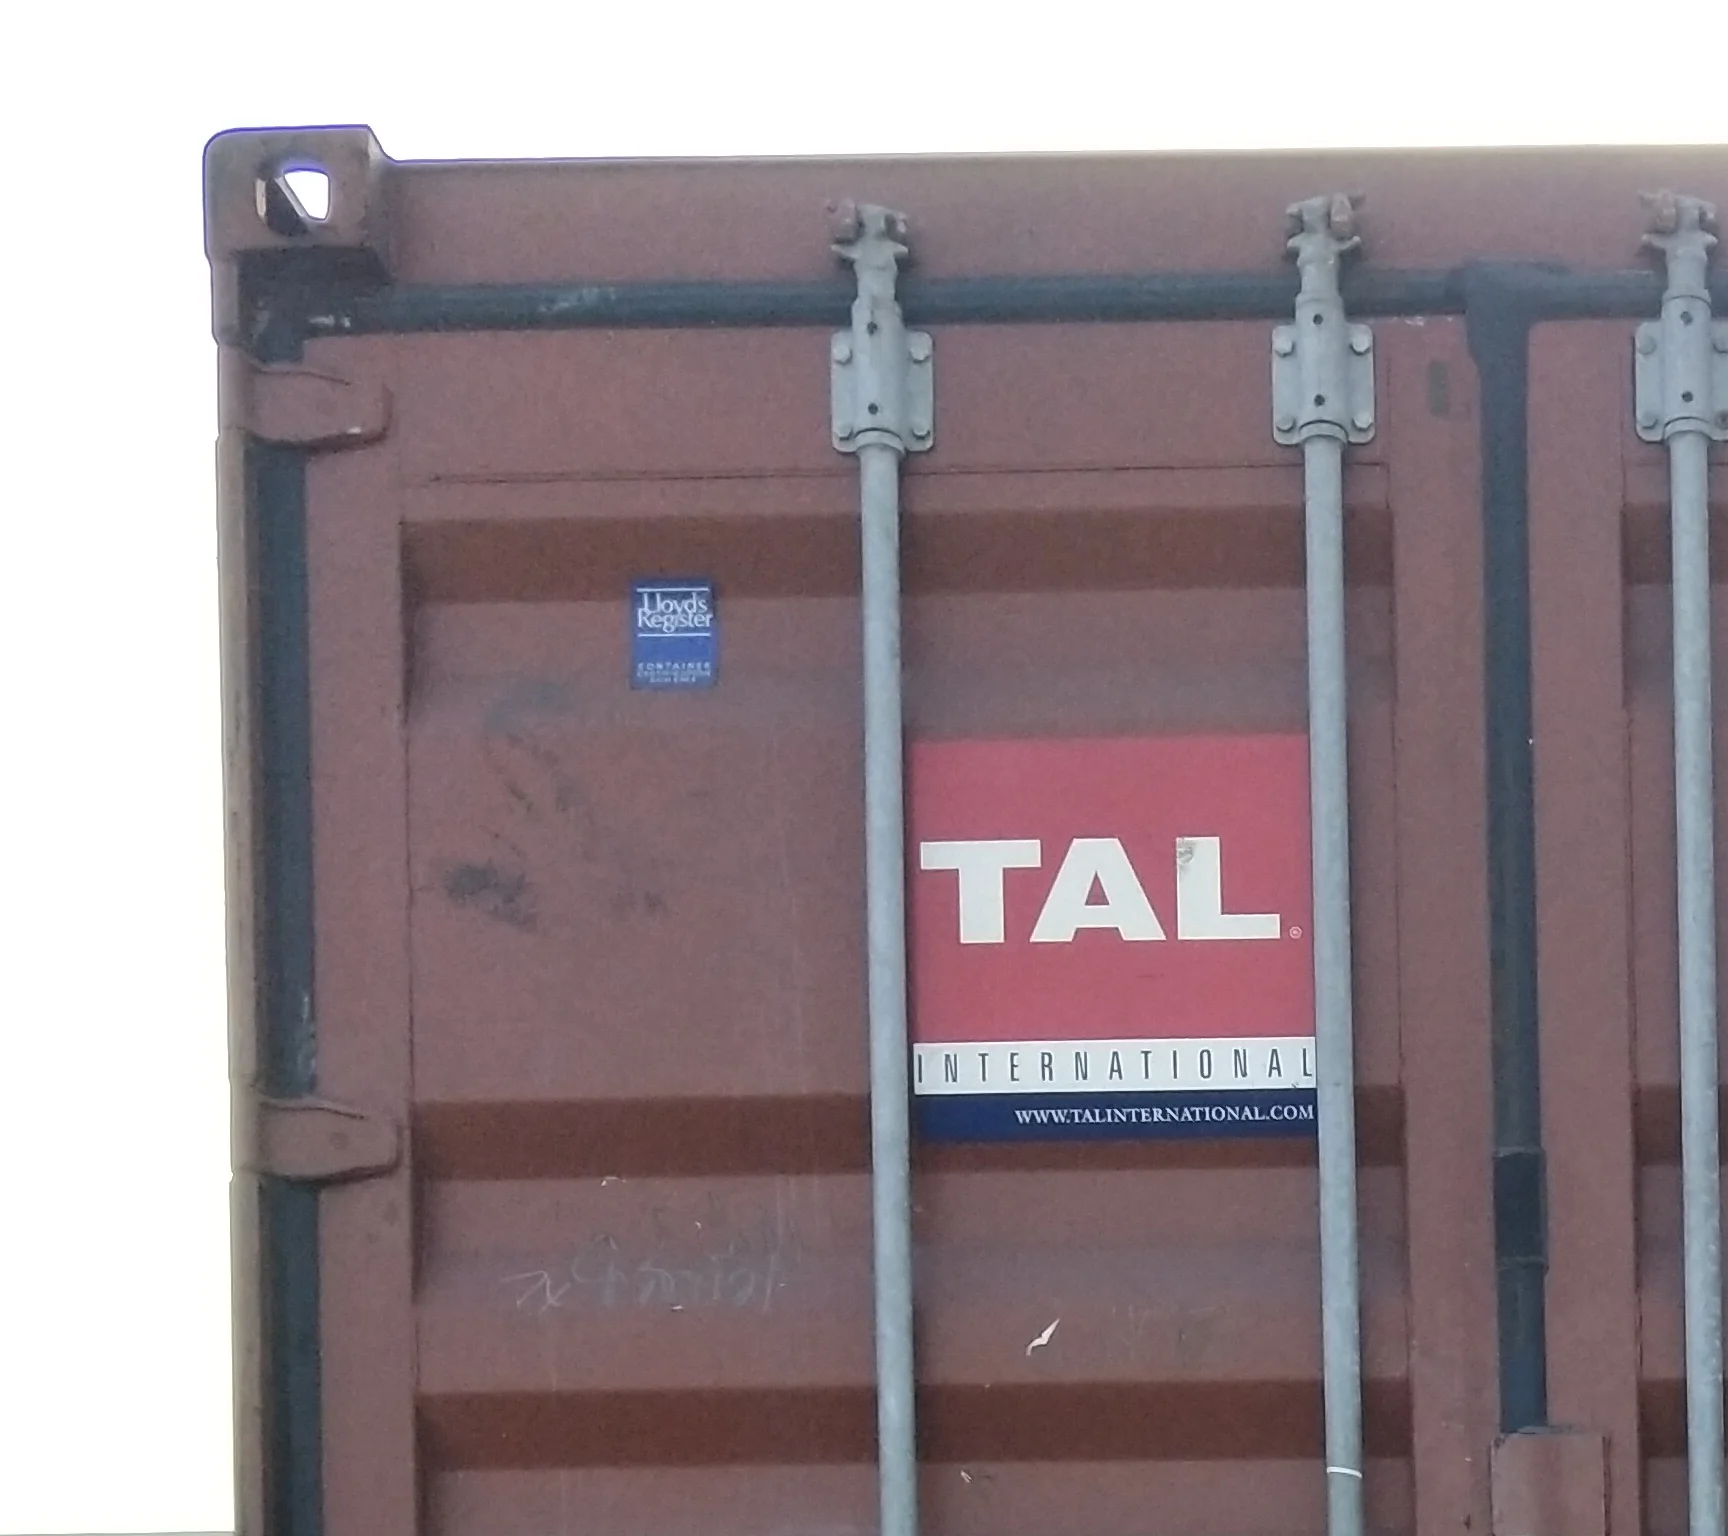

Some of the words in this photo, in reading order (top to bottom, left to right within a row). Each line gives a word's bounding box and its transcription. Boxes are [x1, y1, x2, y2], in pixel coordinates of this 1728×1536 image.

[637, 608, 714, 633] Register
[920, 836, 1281, 944] TAL
[917, 1047, 1313, 1084] INTERNATIONAL
[1014, 1104, 1314, 1124] WWW.TALINTERNATIONAL.COM
